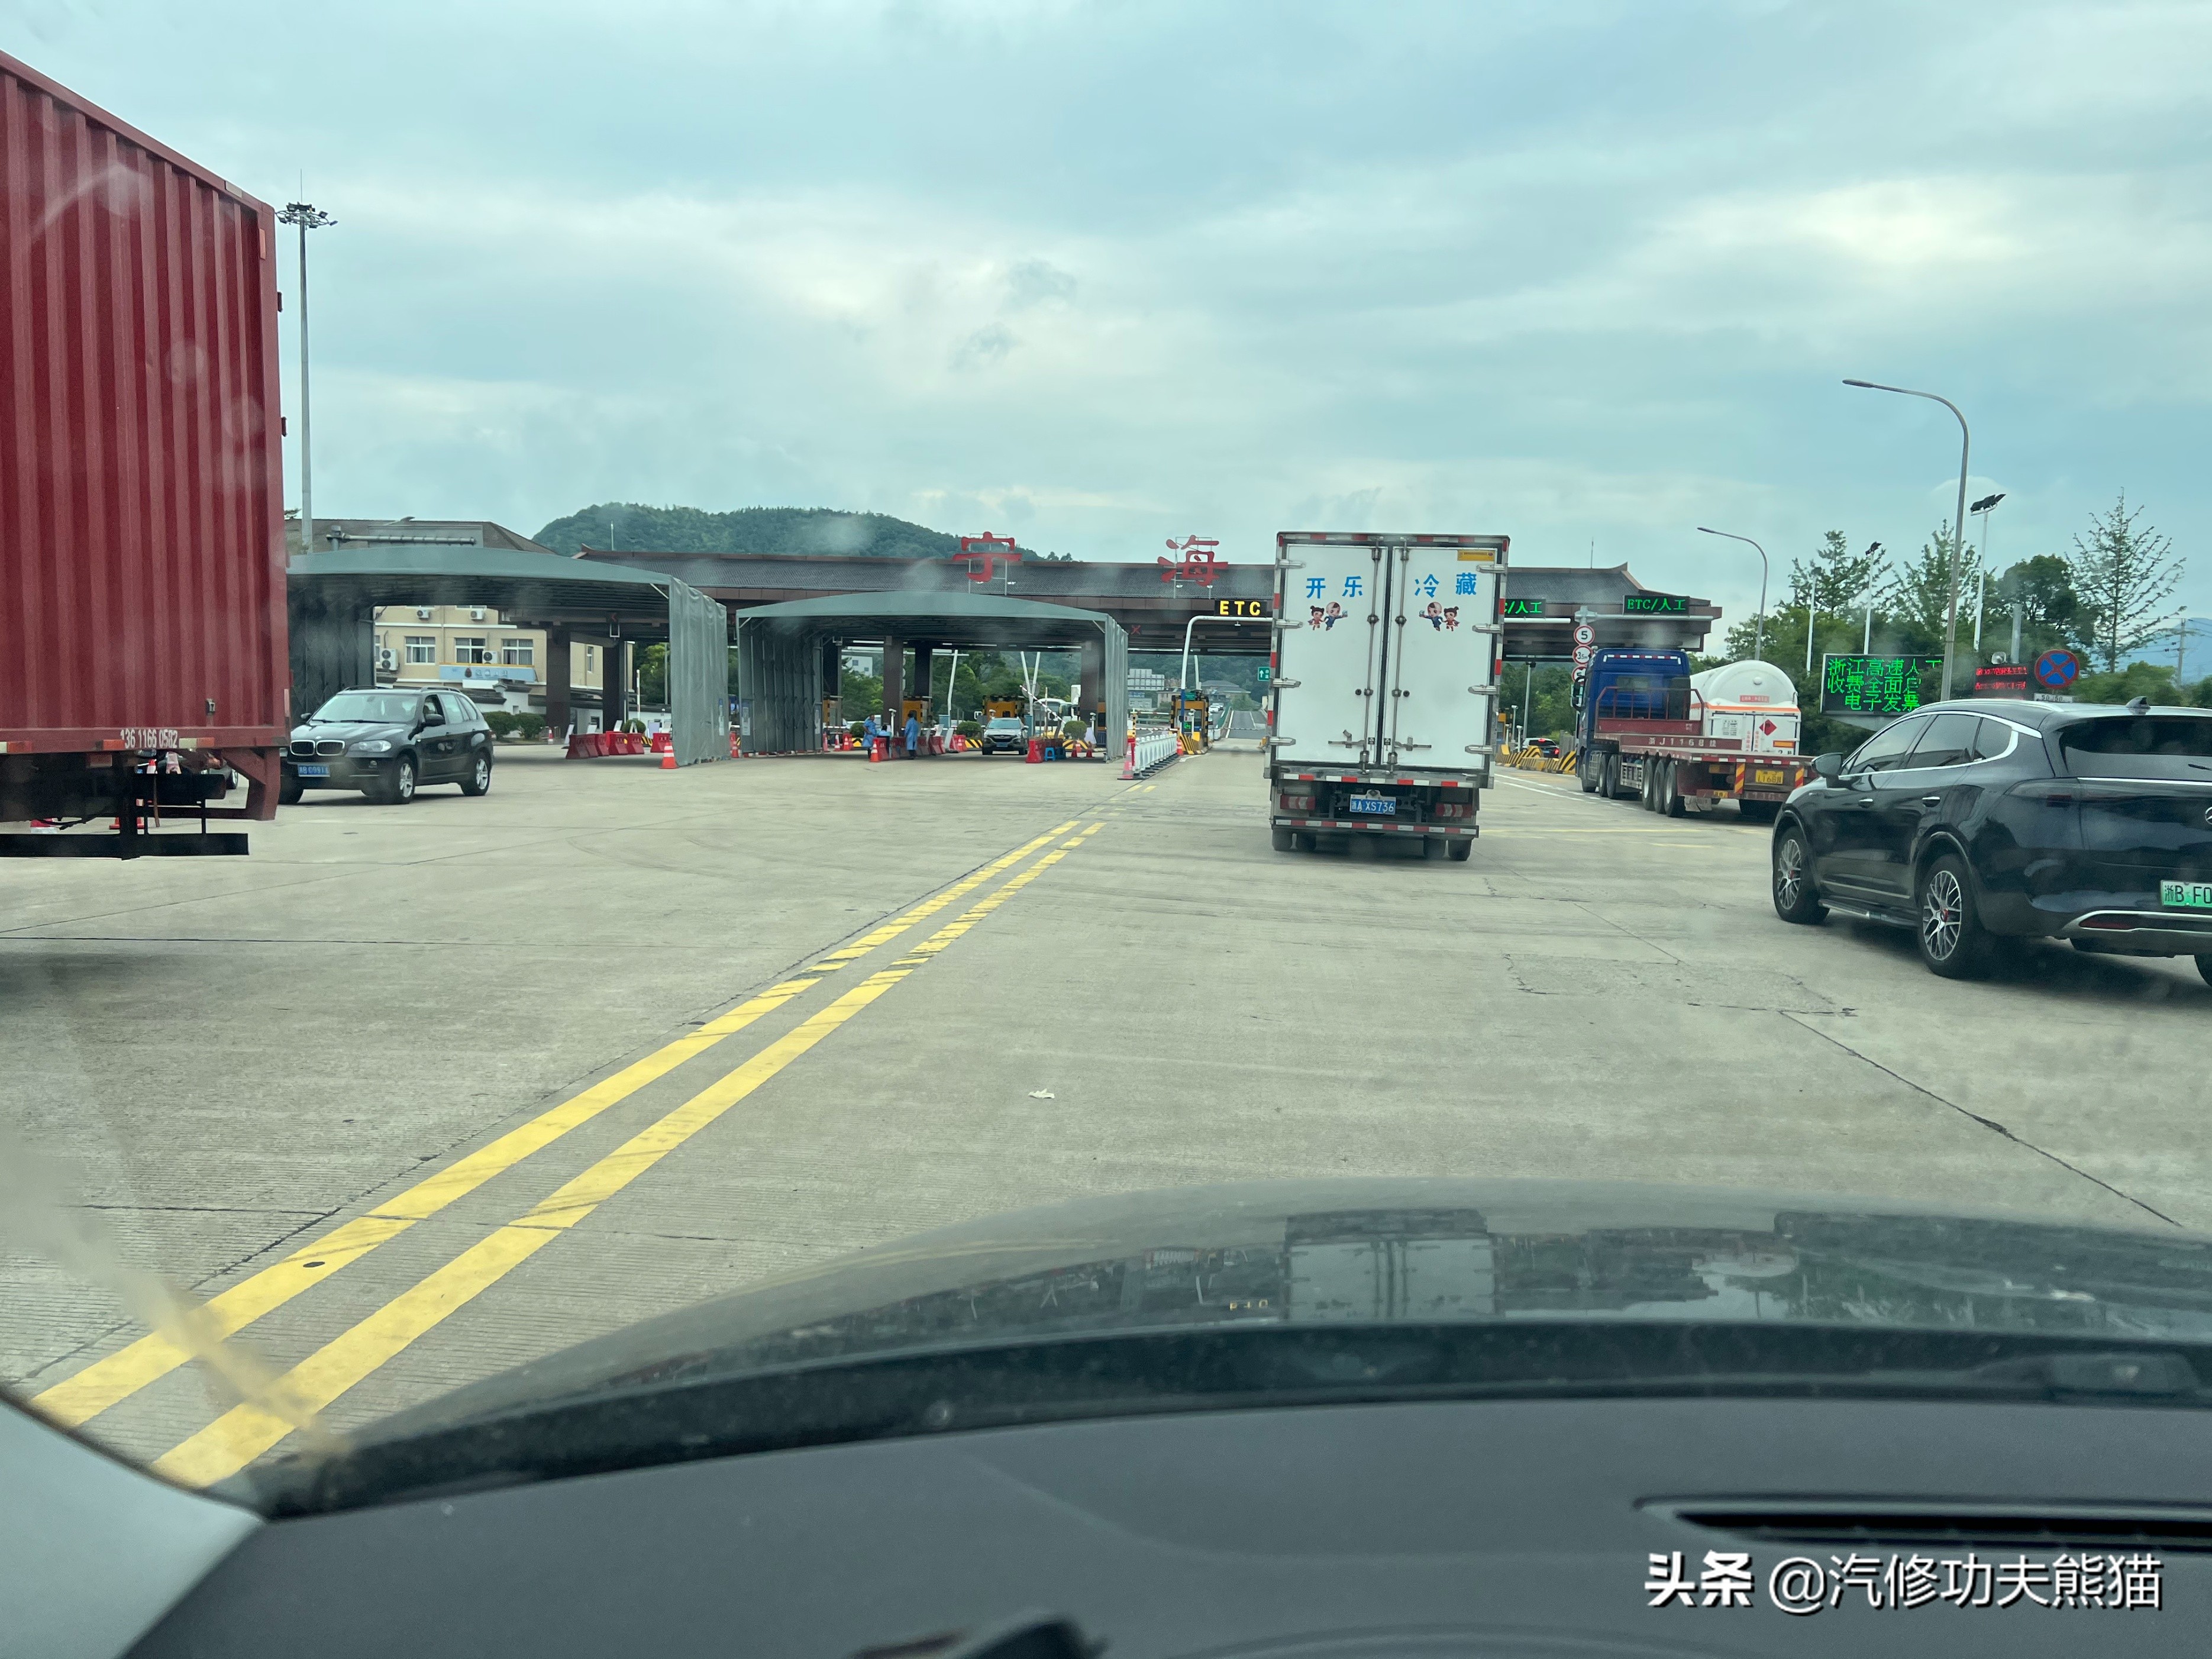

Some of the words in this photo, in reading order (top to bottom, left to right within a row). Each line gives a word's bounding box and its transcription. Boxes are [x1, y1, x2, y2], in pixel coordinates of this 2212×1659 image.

[952, 532, 1229, 586] 宁海
[1306, 576, 1363, 599] 开乐
[1415, 572, 1477, 598] 冷藏
[1220, 600, 1261, 616] ETC
[1627, 598, 1686, 611] ETC/人工
[1581, 630, 1588, 640] 5
[1845, 693, 1920, 712] 电子发票
[120, 728, 135, 749] 136
[138, 728, 157, 748] 1166
